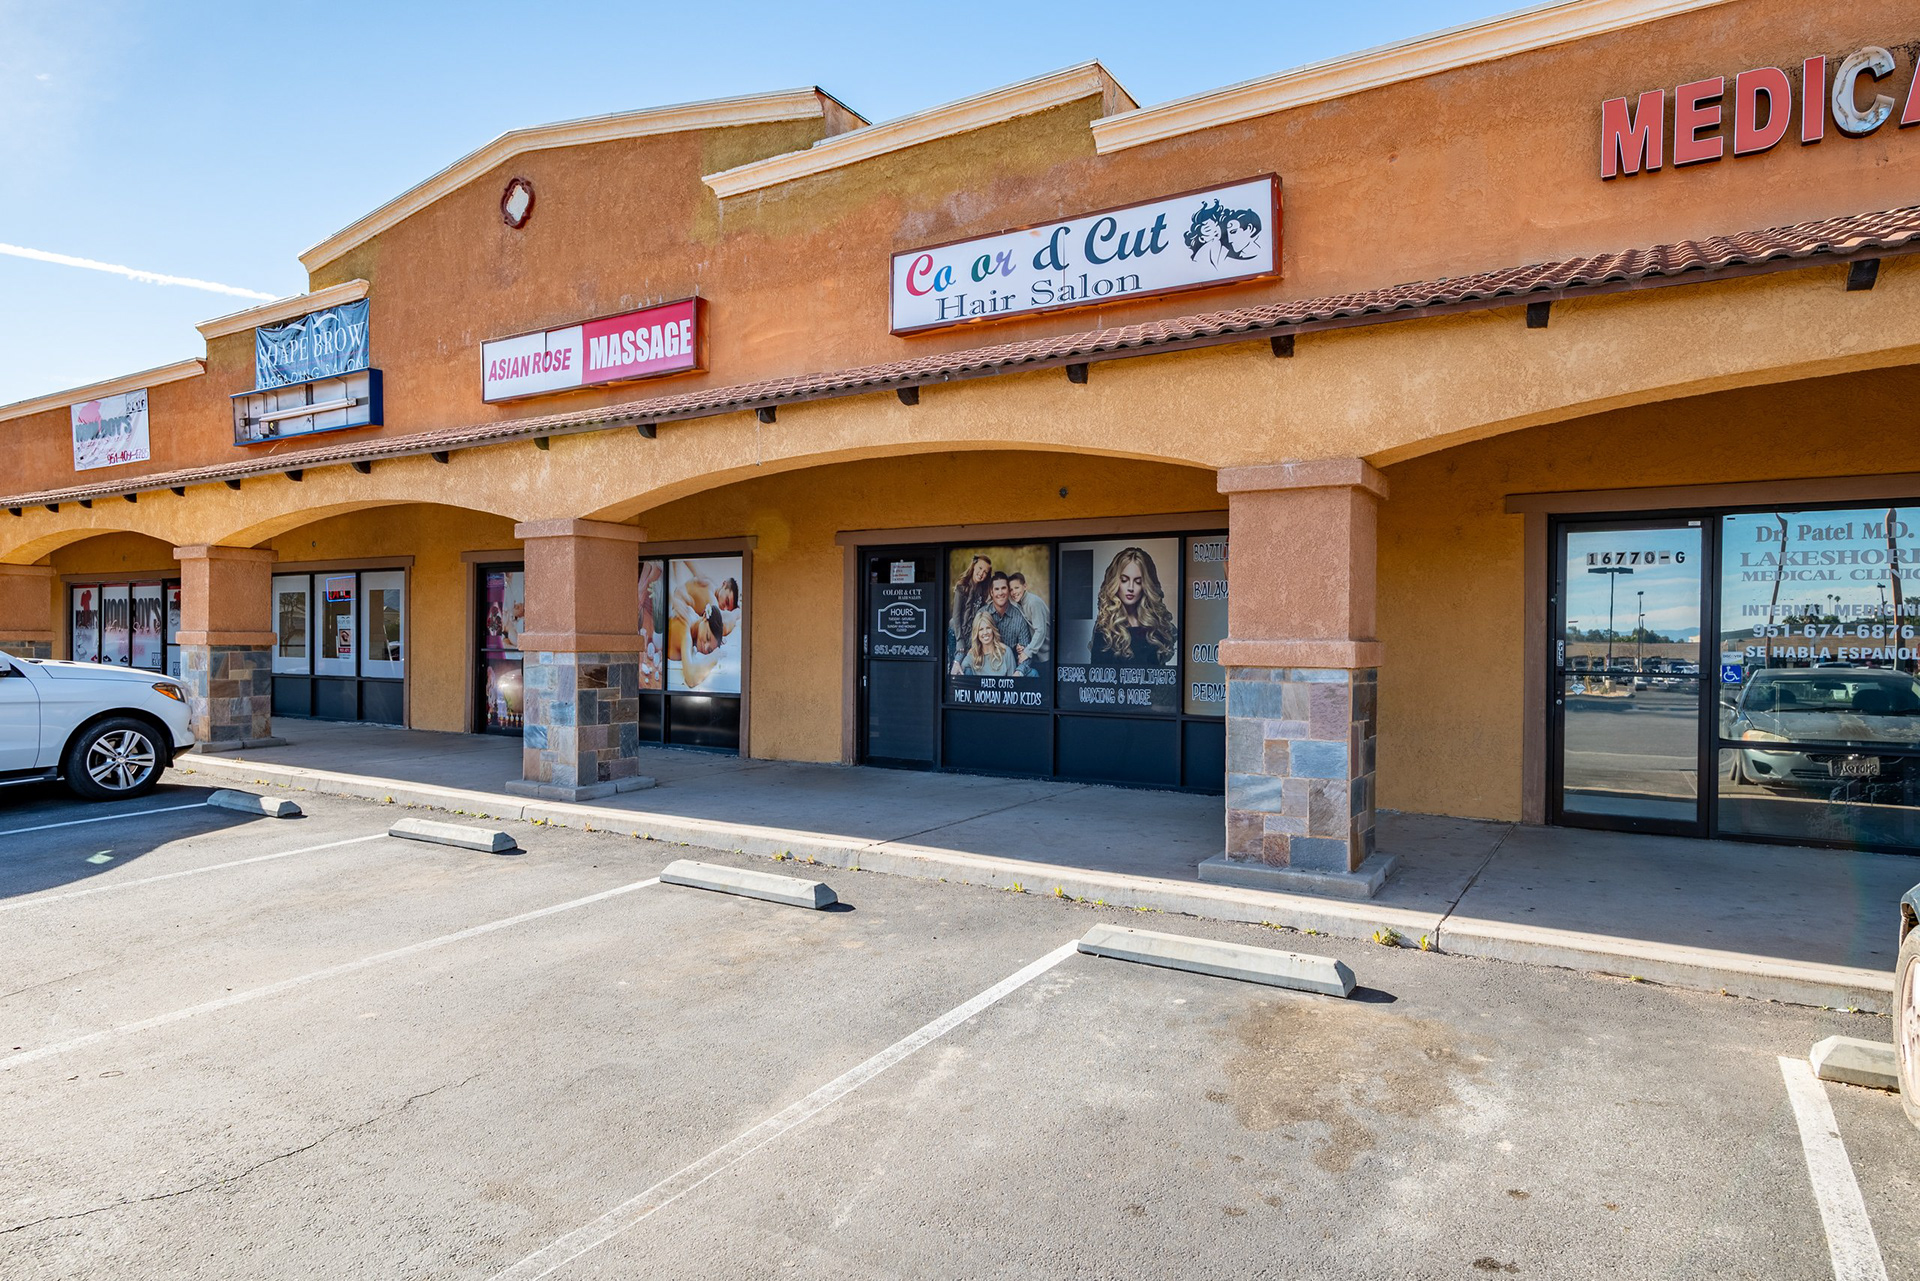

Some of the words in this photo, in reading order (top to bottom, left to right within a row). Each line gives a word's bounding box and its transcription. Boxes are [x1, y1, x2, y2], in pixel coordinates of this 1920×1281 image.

[1600, 45, 1920, 180] MEDIC
[1084, 212, 1169, 265] Cut
[934, 290, 1016, 321] Hair
[1030, 273, 1142, 307] Salon
[259, 337, 309, 369] SHAPE
[313, 322, 365, 358] BROW
[589, 319, 692, 370] MASSAGE
[488, 355, 531, 382] ASIAN
[531, 348, 572, 373] ROSE
[1755, 526, 1789, 543] Dr.
[1797, 522, 1853, 541] Patel
[1861, 521, 1915, 539] M.D.
[1588, 551, 1686, 565] 16770-G
[1741, 569, 1842, 582] MEDICAL
[1193, 580, 1229, 600] BALAY
[890, 608, 914, 616] HOURS
[1742, 604, 1829, 617] INTERNAL
[1834, 604, 1920, 617] MEDICIN
[1752, 623, 1915, 639] 951-674-6876
[874, 644, 930, 656] 951-674-6054
[1745, 645, 1766, 658] SE
[1772, 646, 1831, 659] HABLA
[1838, 645, 1920, 660] ESPAÑOL
[980, 678, 996, 688] HAIR
[998, 678, 1015, 689] CUTS
[1057, 666, 1087, 683] PERMS,
[1089, 667, 1118, 685] COLOR,
[954, 689, 972, 703] MEN,
[974, 690, 1001, 704] WOMAN
[1002, 691, 1019, 705] AND
[1020, 692, 1042, 705] KIDS
[1079, 687, 1115, 704] WAXING
[1117, 688, 1125, 704] &
[1127, 688, 1152, 705] MORE
